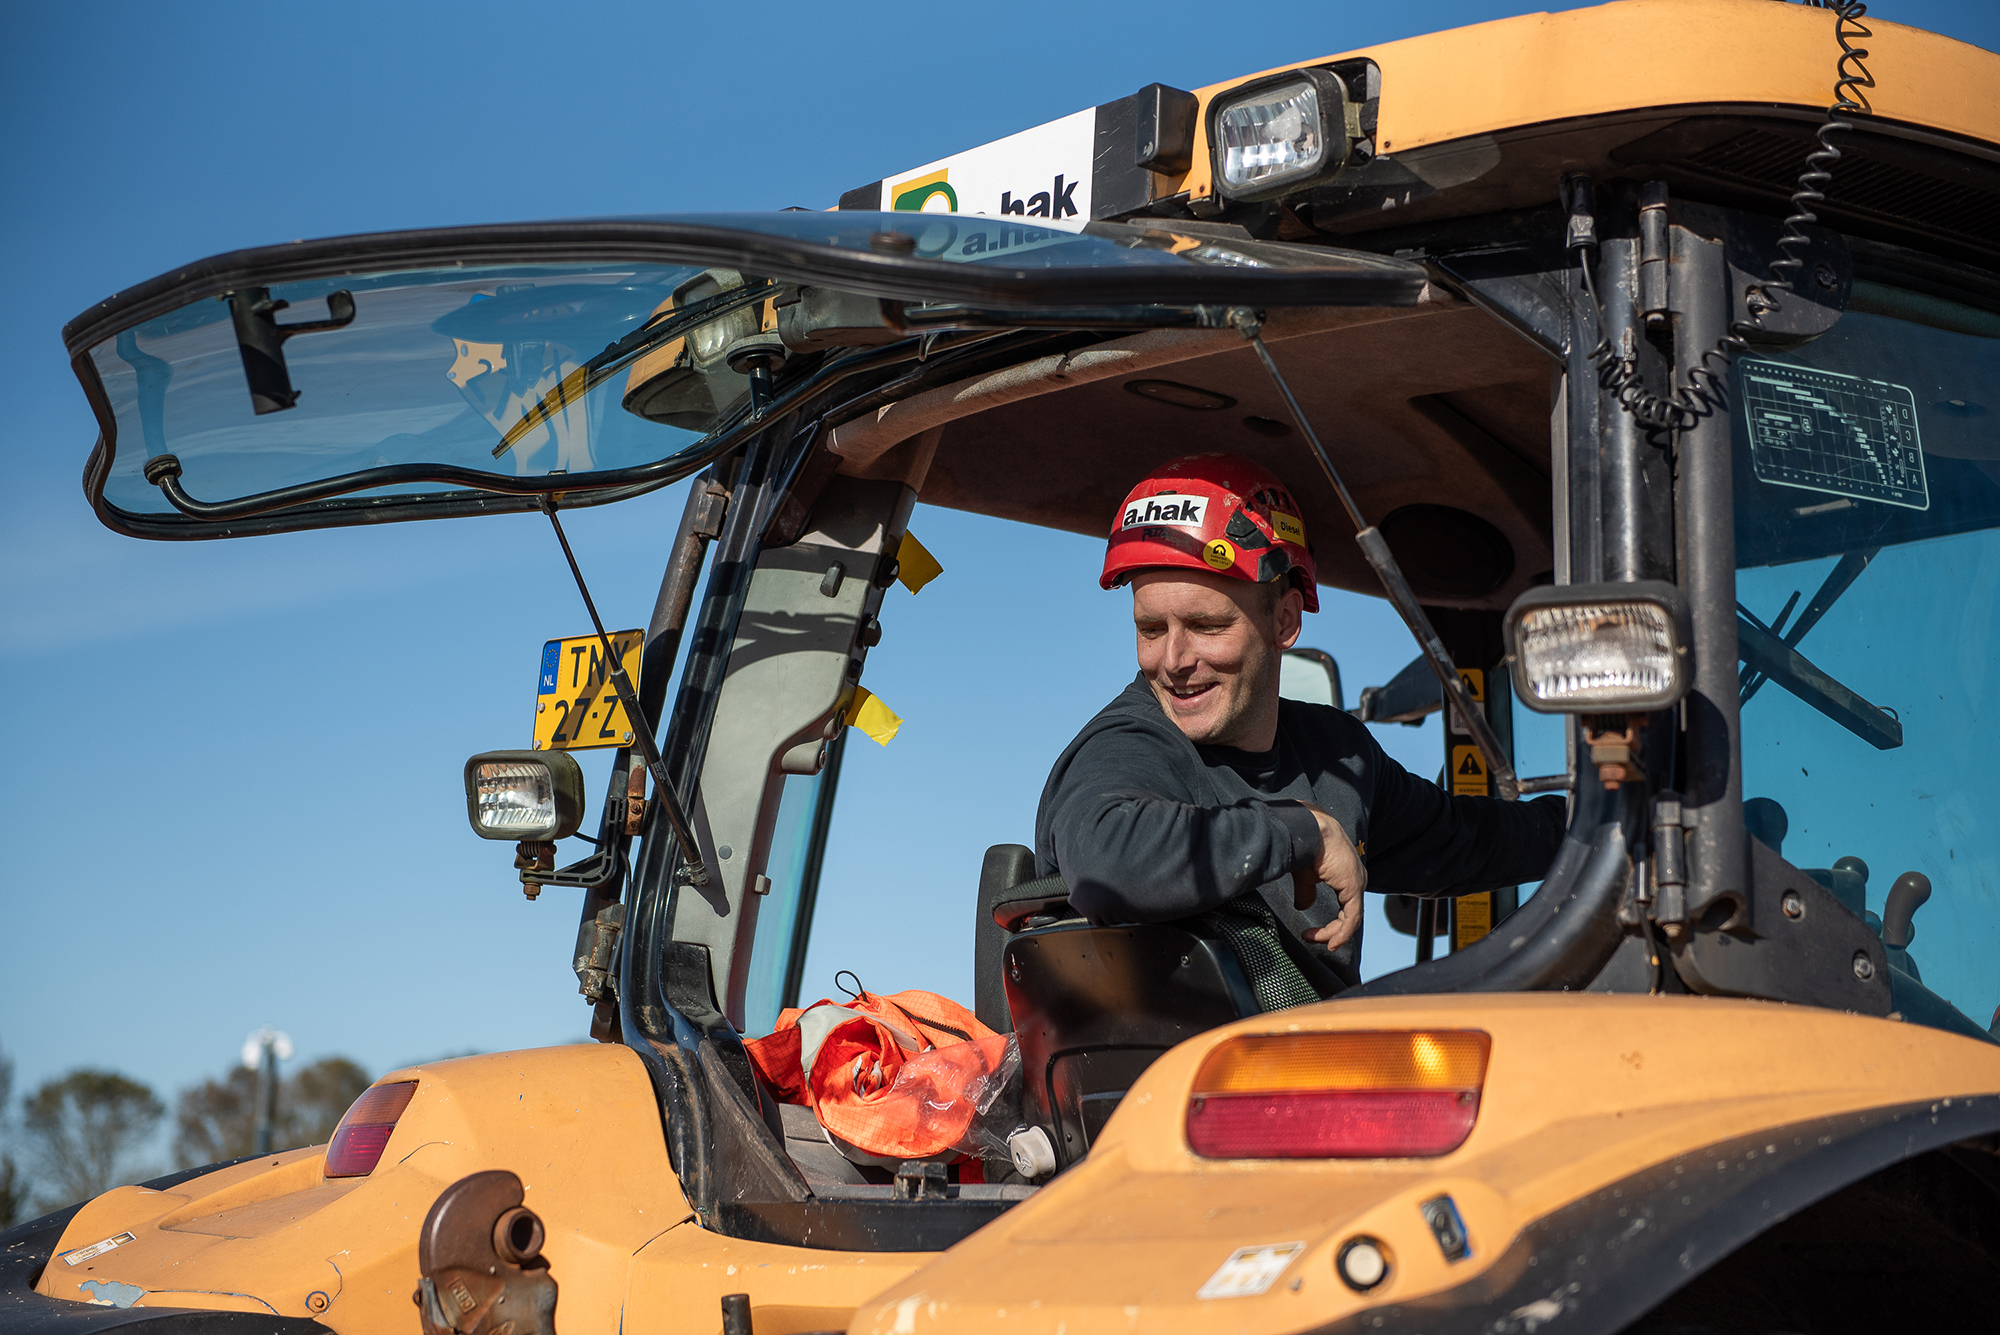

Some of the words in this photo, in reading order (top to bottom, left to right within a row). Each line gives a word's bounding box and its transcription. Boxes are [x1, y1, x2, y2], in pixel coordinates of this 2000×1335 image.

[1123, 500, 1200, 526] a.hak
[1280, 521, 1301, 536] Diesel
[543, 674, 554, 687] NL
